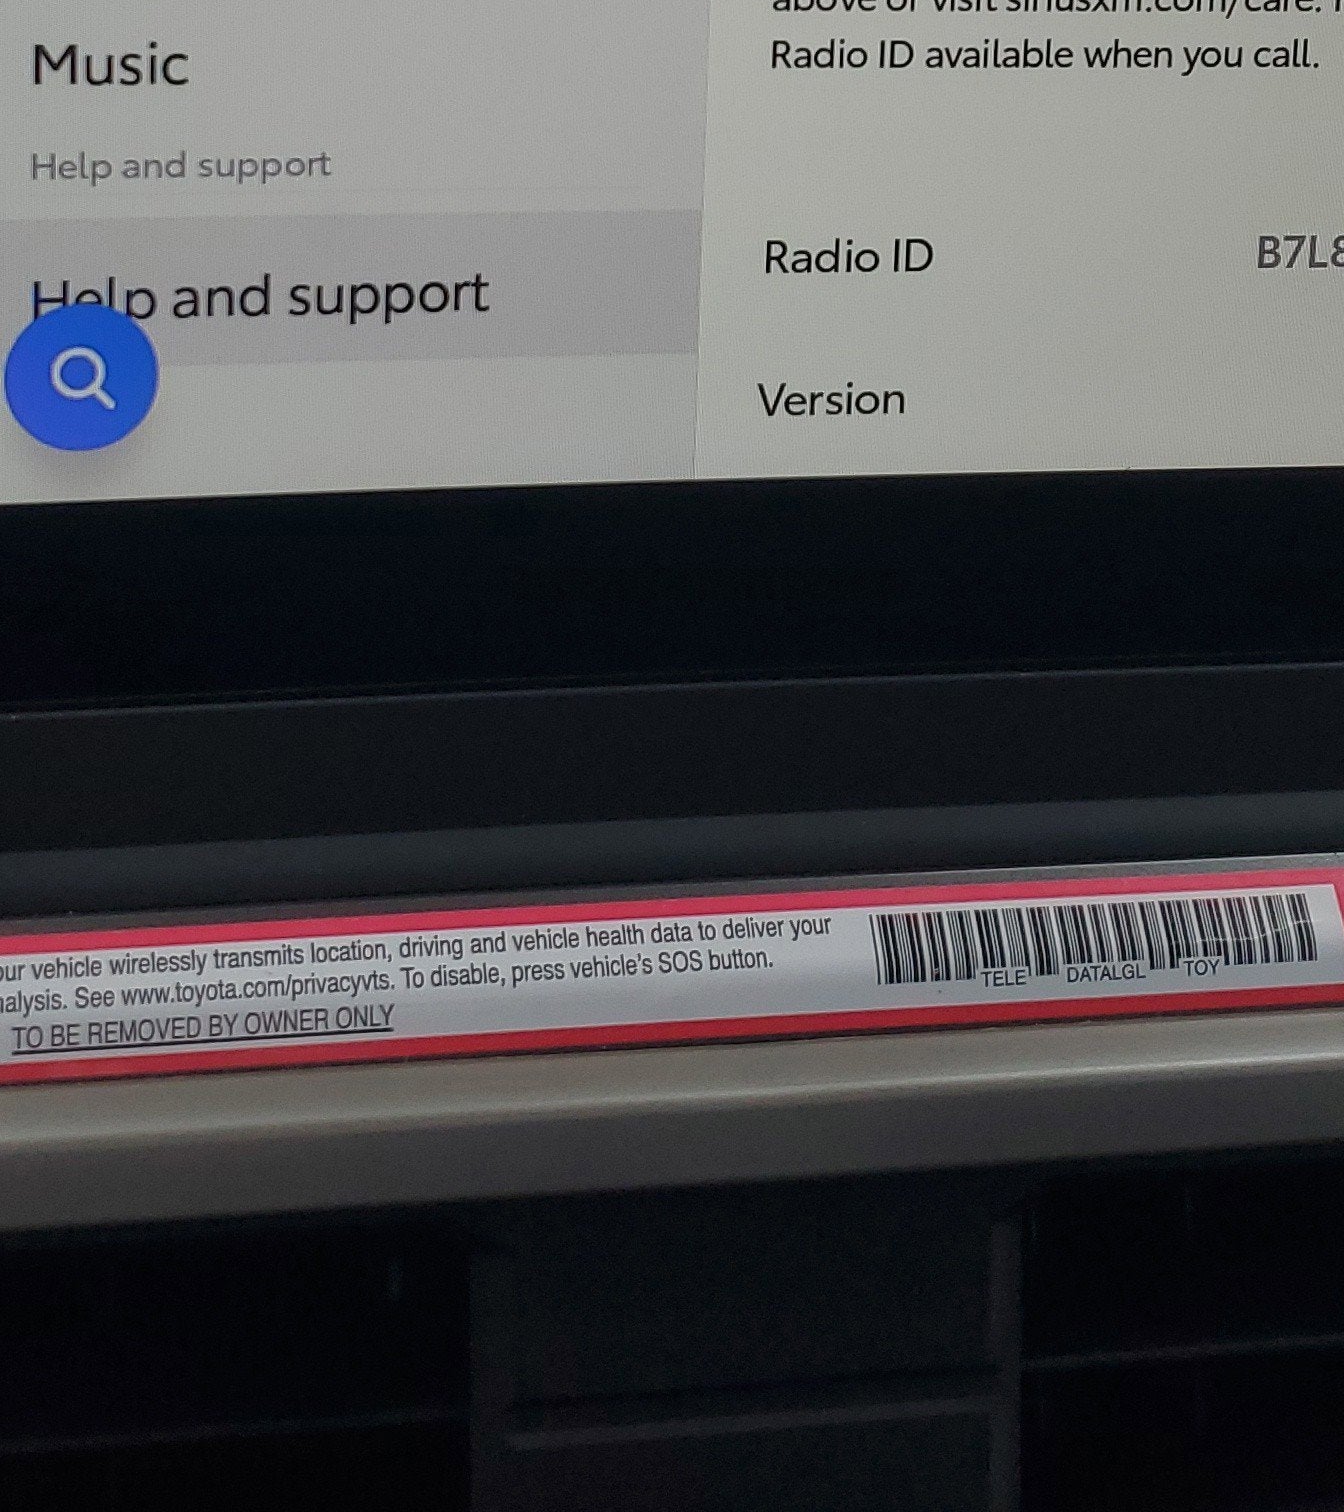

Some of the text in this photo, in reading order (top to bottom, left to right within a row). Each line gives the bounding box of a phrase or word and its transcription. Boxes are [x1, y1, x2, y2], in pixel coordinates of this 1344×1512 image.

[33, 43, 189, 86] Music
[771, 38, 1319, 76] Radio ID available when you call.
[31, 150, 331, 187] Help and support
[764, 239, 934, 275] Radio ID
[173, 273, 271, 318] and
[288, 273, 489, 324] support
[758, 383, 906, 417] Version
[31, 956, 102, 981] vehicle
[109, 948, 205, 977] wirelessly
[213, 943, 304, 969] transmits
[310, 938, 392, 964] location,
[399, 934, 463, 961] driving
[470, 931, 506, 955] and
[512, 927, 580, 952] vehicle
[586, 923, 644, 947] health
[651, 921, 692, 943] data
[698, 920, 717, 941] to
[723, 918, 784, 939] deliver
[789, 916, 832, 941] your
[75, 986, 115, 1007] See
[122, 970, 395, 1006] www.toyota.com/privacyvts.
[400, 967, 426, 988] To
[430, 961, 506, 988] disable,
[511, 957, 565, 988] press
[658, 951, 703, 973] SOS
[709, 949, 774, 971] button.
[982, 958, 1220, 987] TELE DATALGL TOY
[12, 1004, 395, 1049] TO BE REMOVED BY OWNER ONLY
